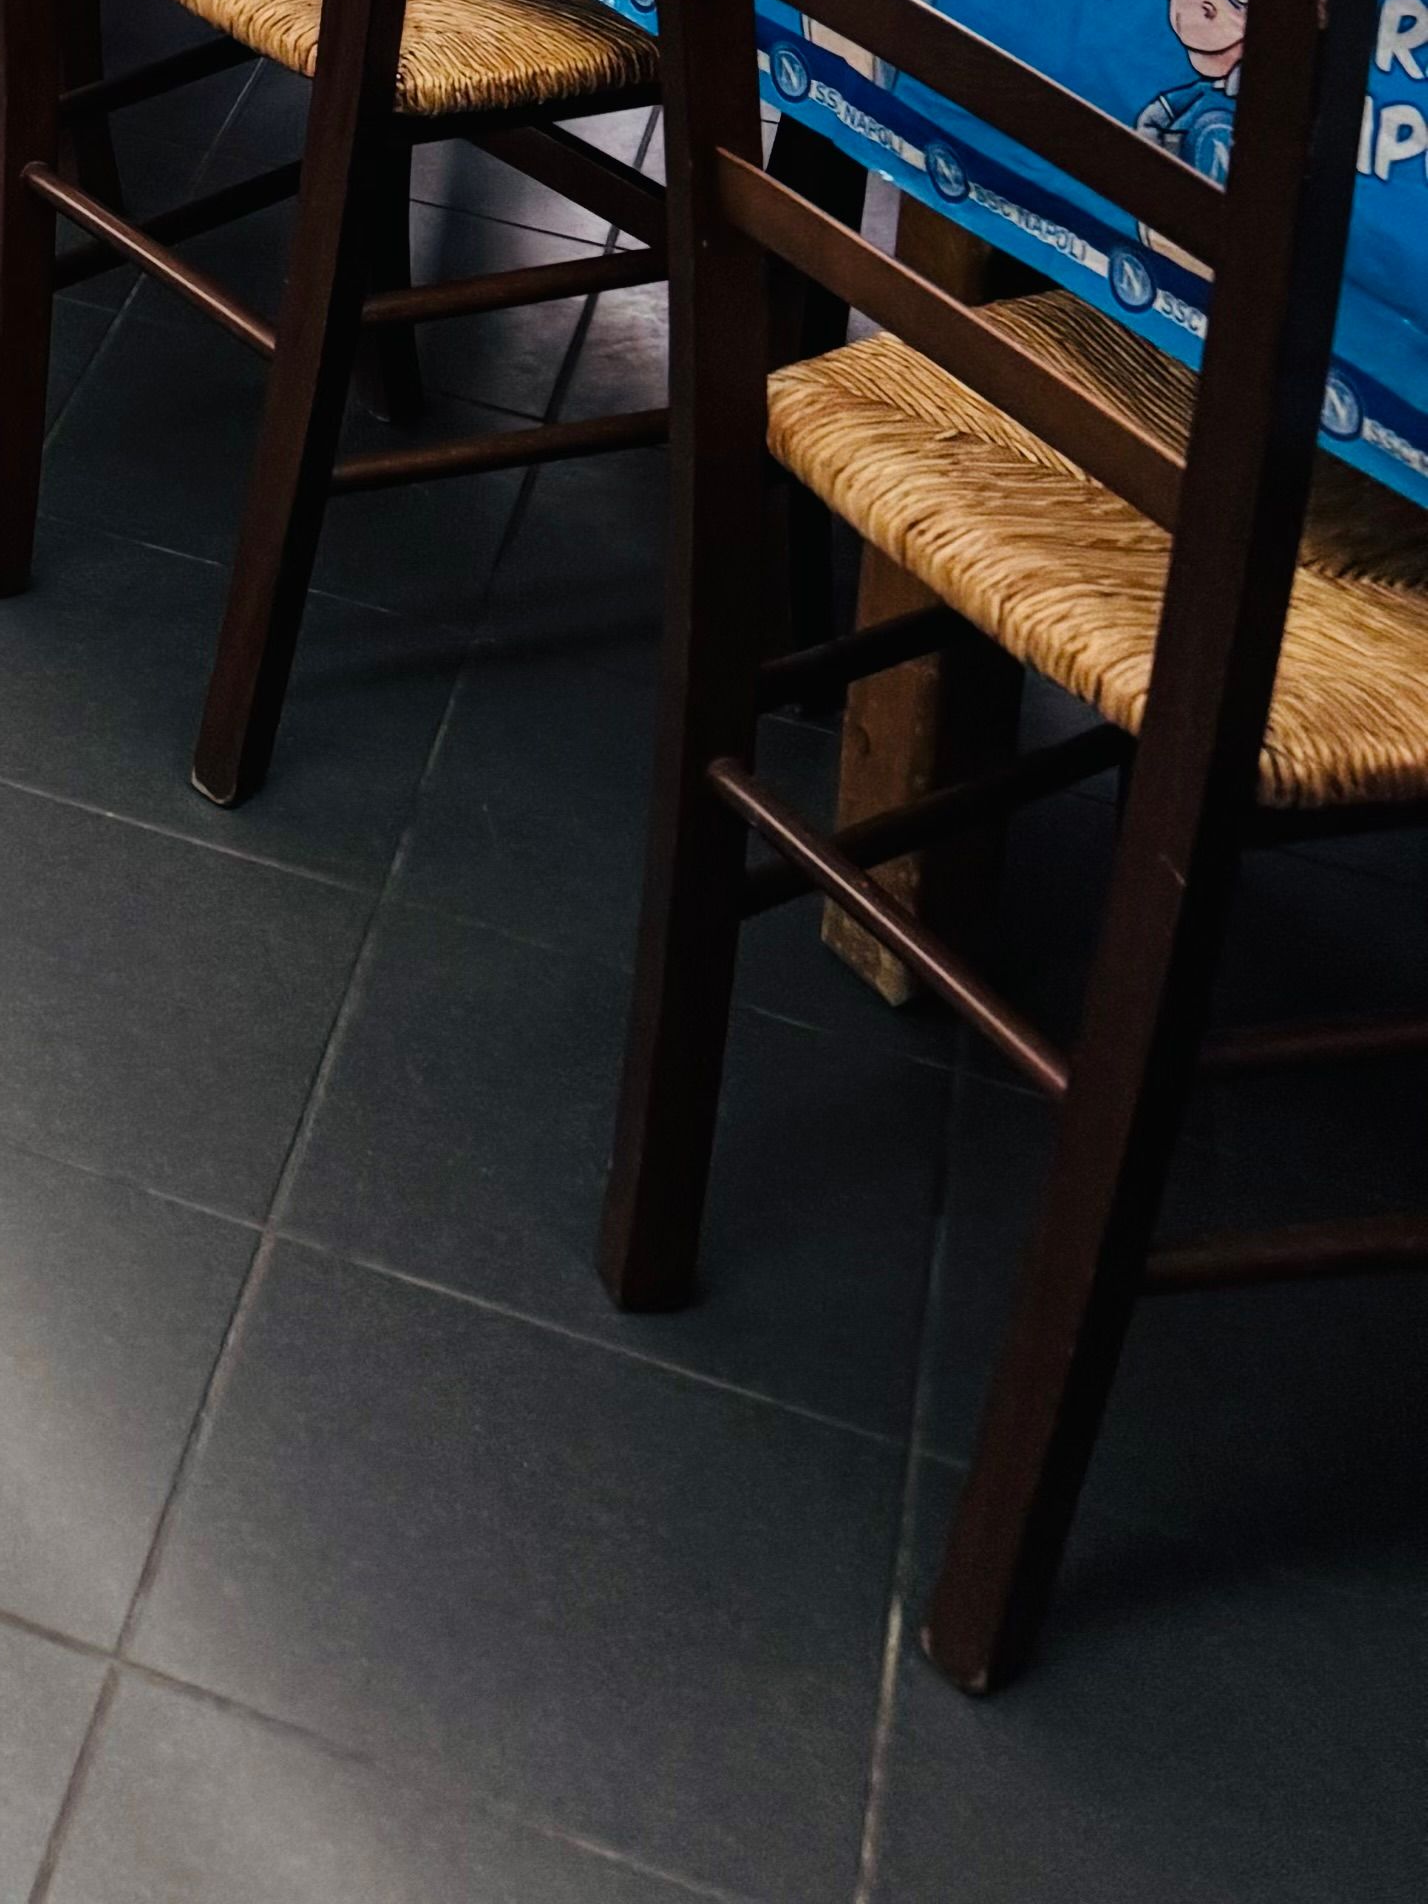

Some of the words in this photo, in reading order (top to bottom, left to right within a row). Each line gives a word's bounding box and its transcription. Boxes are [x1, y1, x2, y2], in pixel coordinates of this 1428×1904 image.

[973, 184, 1011, 218] SSC
[1016, 206, 1087, 262] NAPOLI
[1160, 292, 1203, 332] SSC
